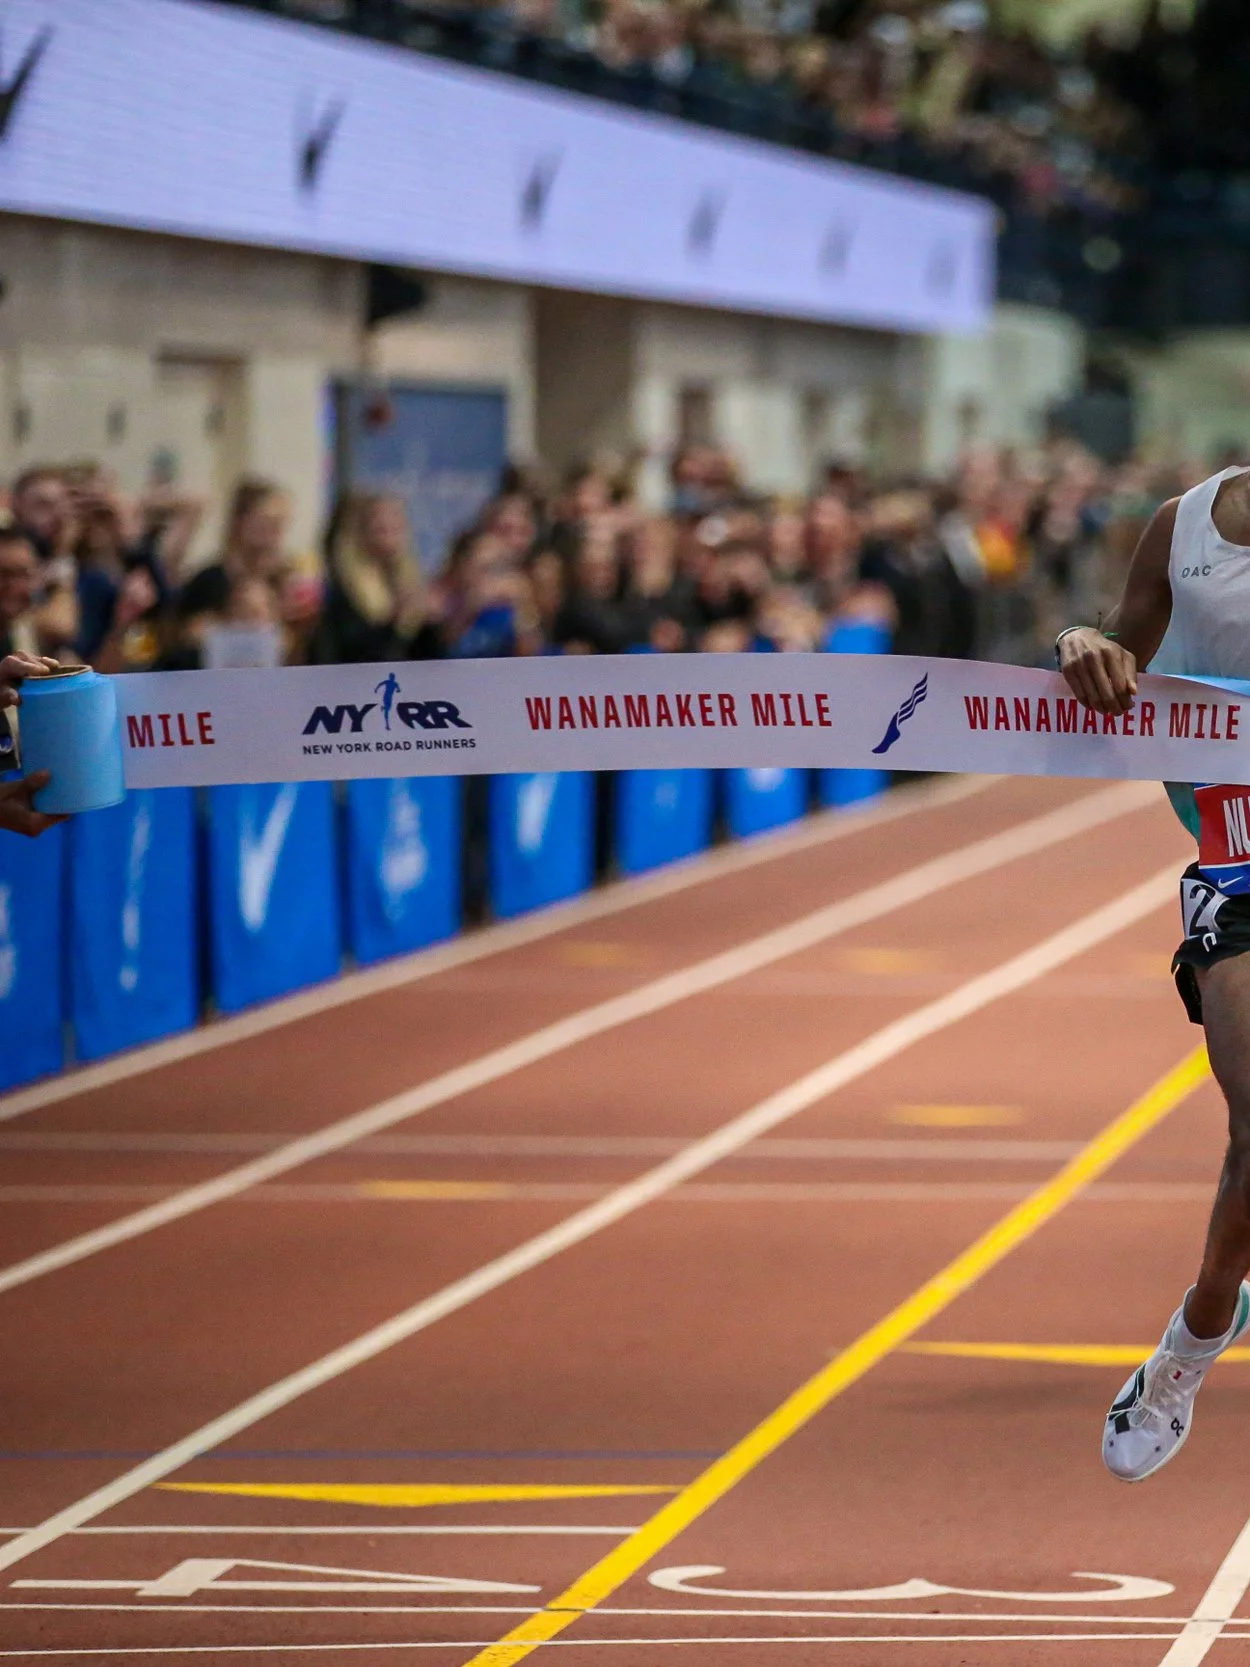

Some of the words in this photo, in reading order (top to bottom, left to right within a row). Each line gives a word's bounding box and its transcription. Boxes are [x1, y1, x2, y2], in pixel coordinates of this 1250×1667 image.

[1181, 565, 1212, 579] OAC
[126, 711, 215, 748] MILE
[525, 693, 738, 730] WANAMAKER
[751, 693, 833, 728] MILE
[964, 695, 1156, 737] WANAMAKER
[1168, 702, 1241, 740] MILE
[303, 744, 333, 755] NEW
[336, 742, 372, 754] YORK
[375, 740, 412, 752] ROAD
[416, 738, 477, 751] RUNNERS
[1189, 884, 1217, 936] 2
